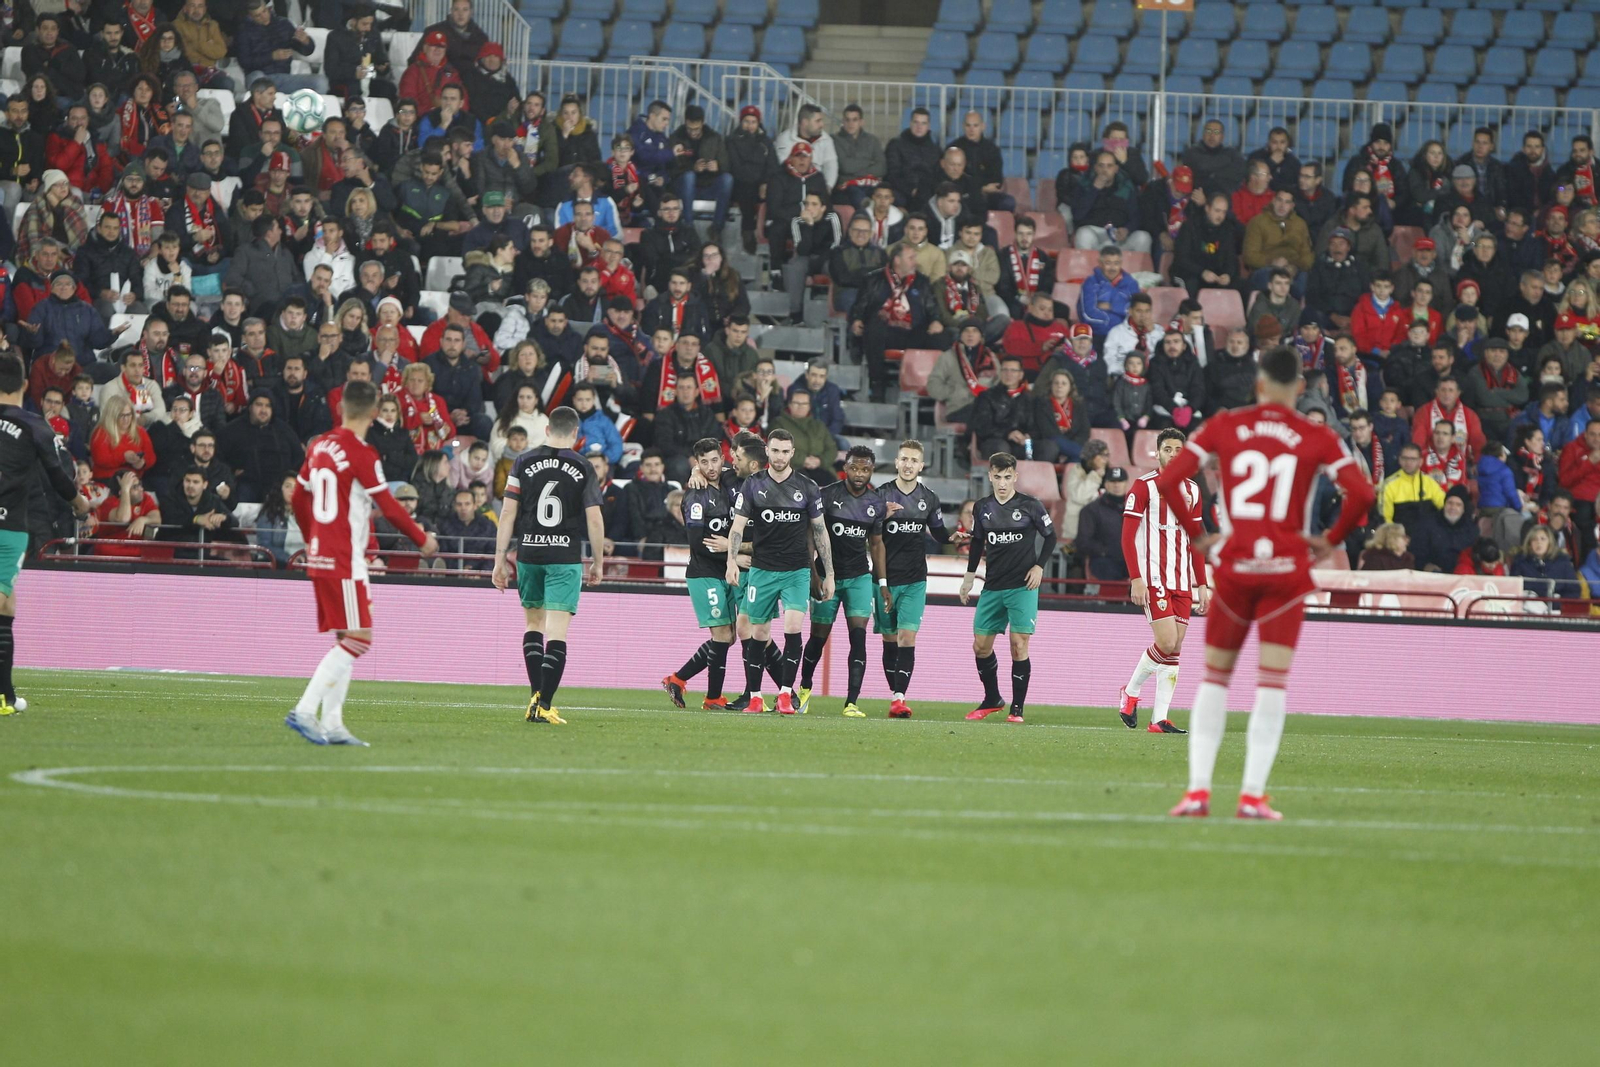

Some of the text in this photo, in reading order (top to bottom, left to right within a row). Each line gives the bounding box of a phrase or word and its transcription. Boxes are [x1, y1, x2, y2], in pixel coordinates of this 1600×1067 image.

[524, 458, 584, 482] SERGIO RUIZ
[1230, 449, 1298, 522] 21
[536, 480, 563, 527] 6
[774, 510, 801, 520] aldro
[522, 533, 570, 544] EL DIARIO
[707, 588, 719, 605] 5
[1156, 586, 1166, 598] 3
